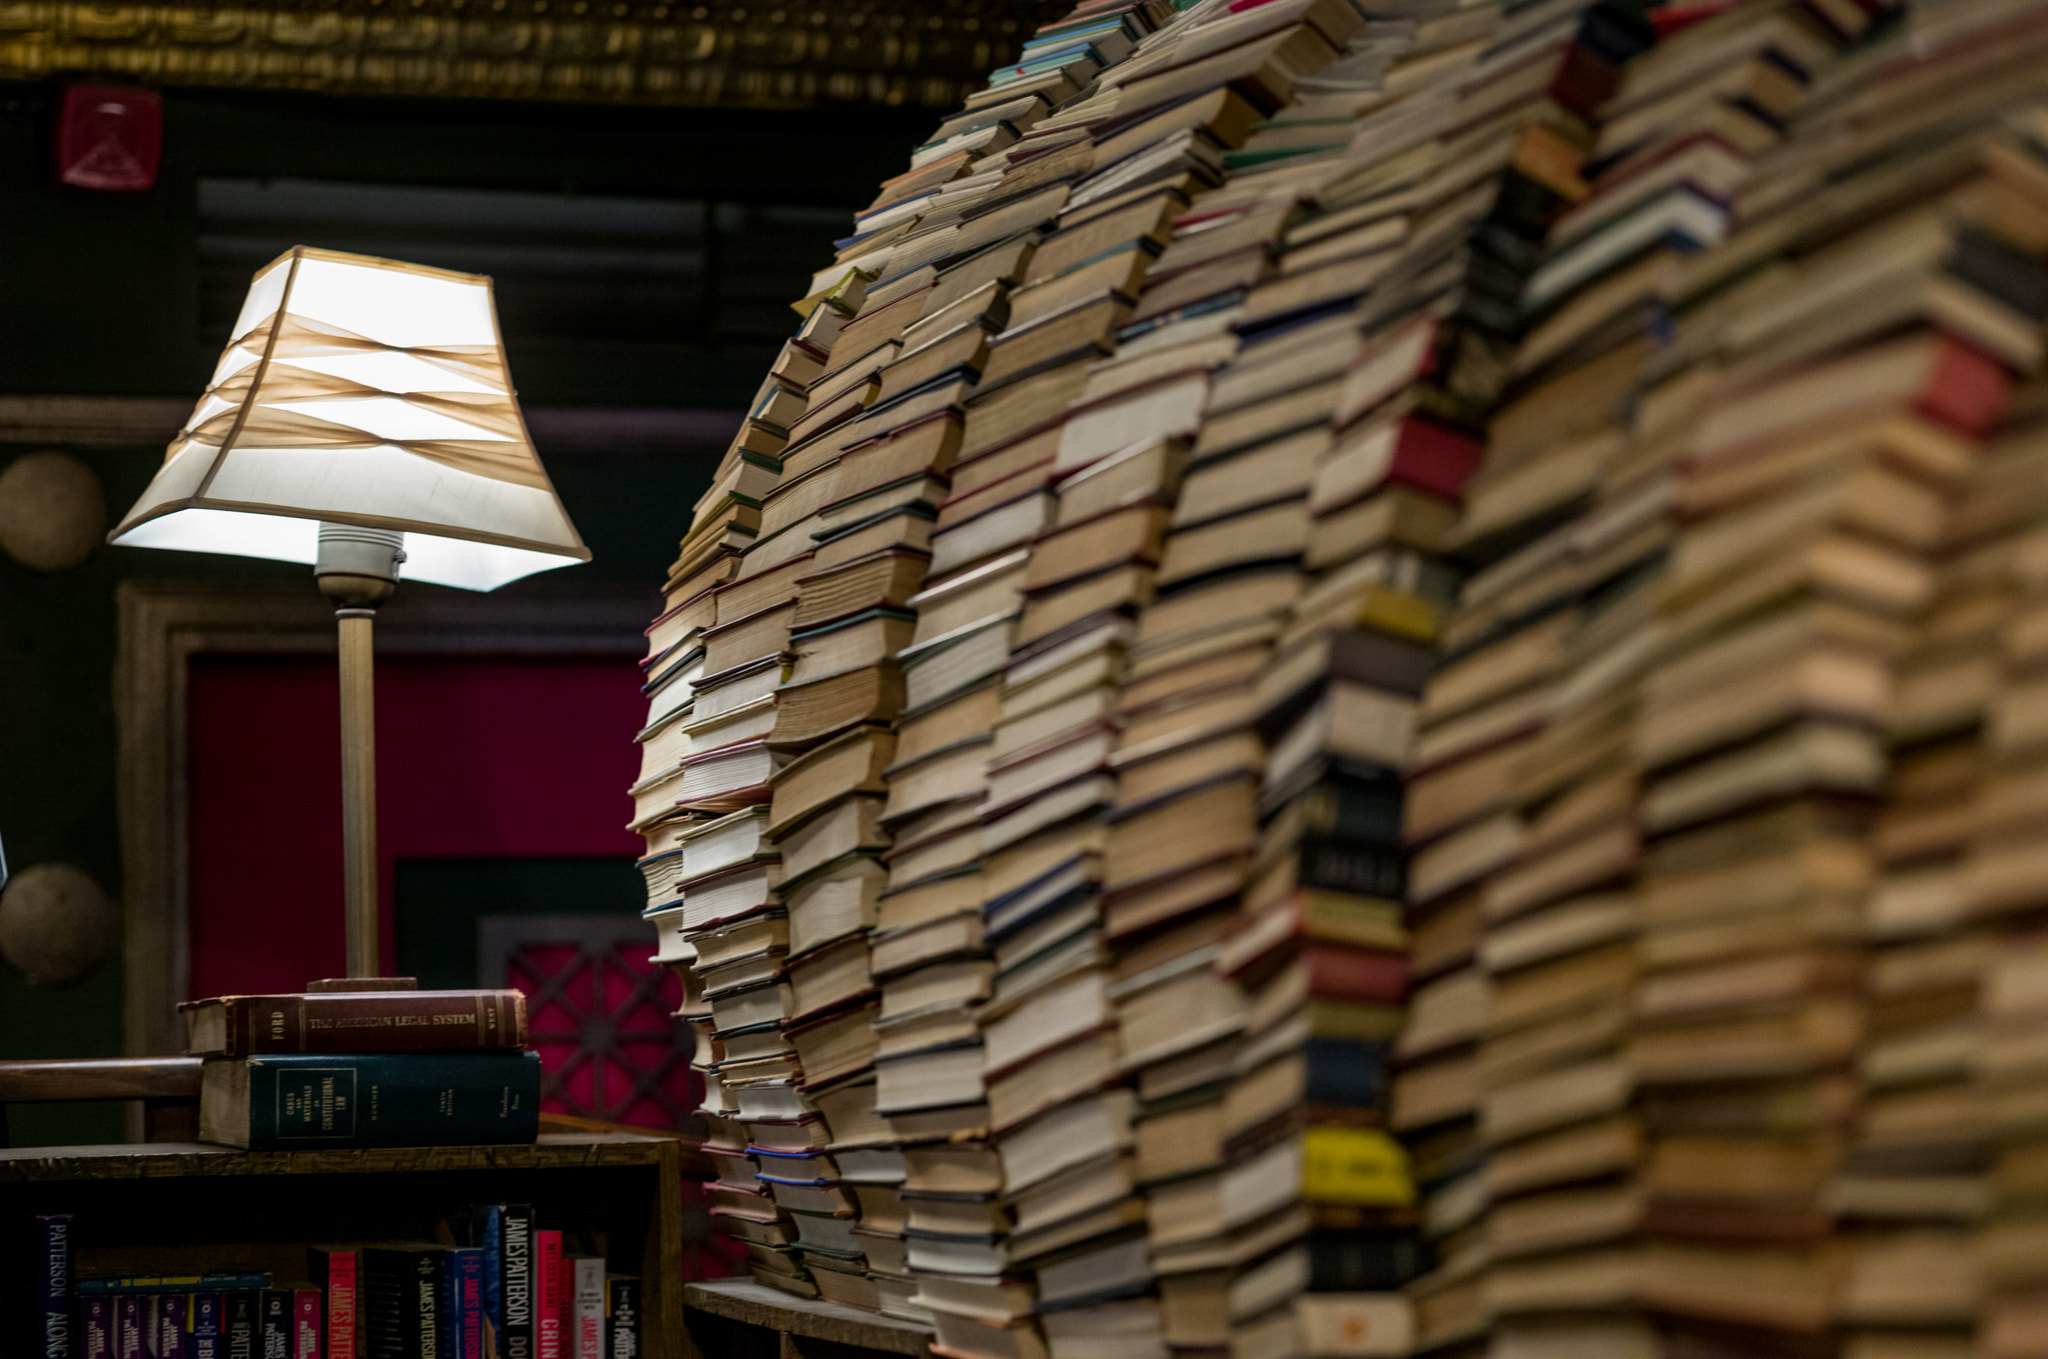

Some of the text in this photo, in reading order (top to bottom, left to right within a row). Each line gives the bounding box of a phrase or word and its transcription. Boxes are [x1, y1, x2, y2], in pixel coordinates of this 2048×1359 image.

[271, 1010, 285, 1041] FORD
[309, 1018, 333, 1029] THE
[395, 1015, 430, 1027] LEGAL
[432, 1013, 476, 1026] SYSTEM
[303, 1084, 313, 1122] MATERIALS
[321, 1077, 334, 1131] CONSTITUTIONAL
[335, 1096, 347, 1111] LAW
[504, 1215, 530, 1327] JAMES PATTERSON
[545, 1243, 557, 1283] MELISSA
[45, 1223, 69, 1359] PATTERSON ALONG
[331, 1283, 354, 1323] JAMES
[418, 1279, 435, 1312] JAMES
[464, 1275, 480, 1308] JAMES
[95, 1327, 105, 1353] JAMES
[130, 1326, 140, 1352] JAMES
[161, 1317, 171, 1358] PATTERSON
[169, 1324, 179, 1350] JAMES
[275, 1331, 287, 1359] JAMES
[307, 1327, 317, 1352] JAMES
[580, 1315, 598, 1351] JAMES
